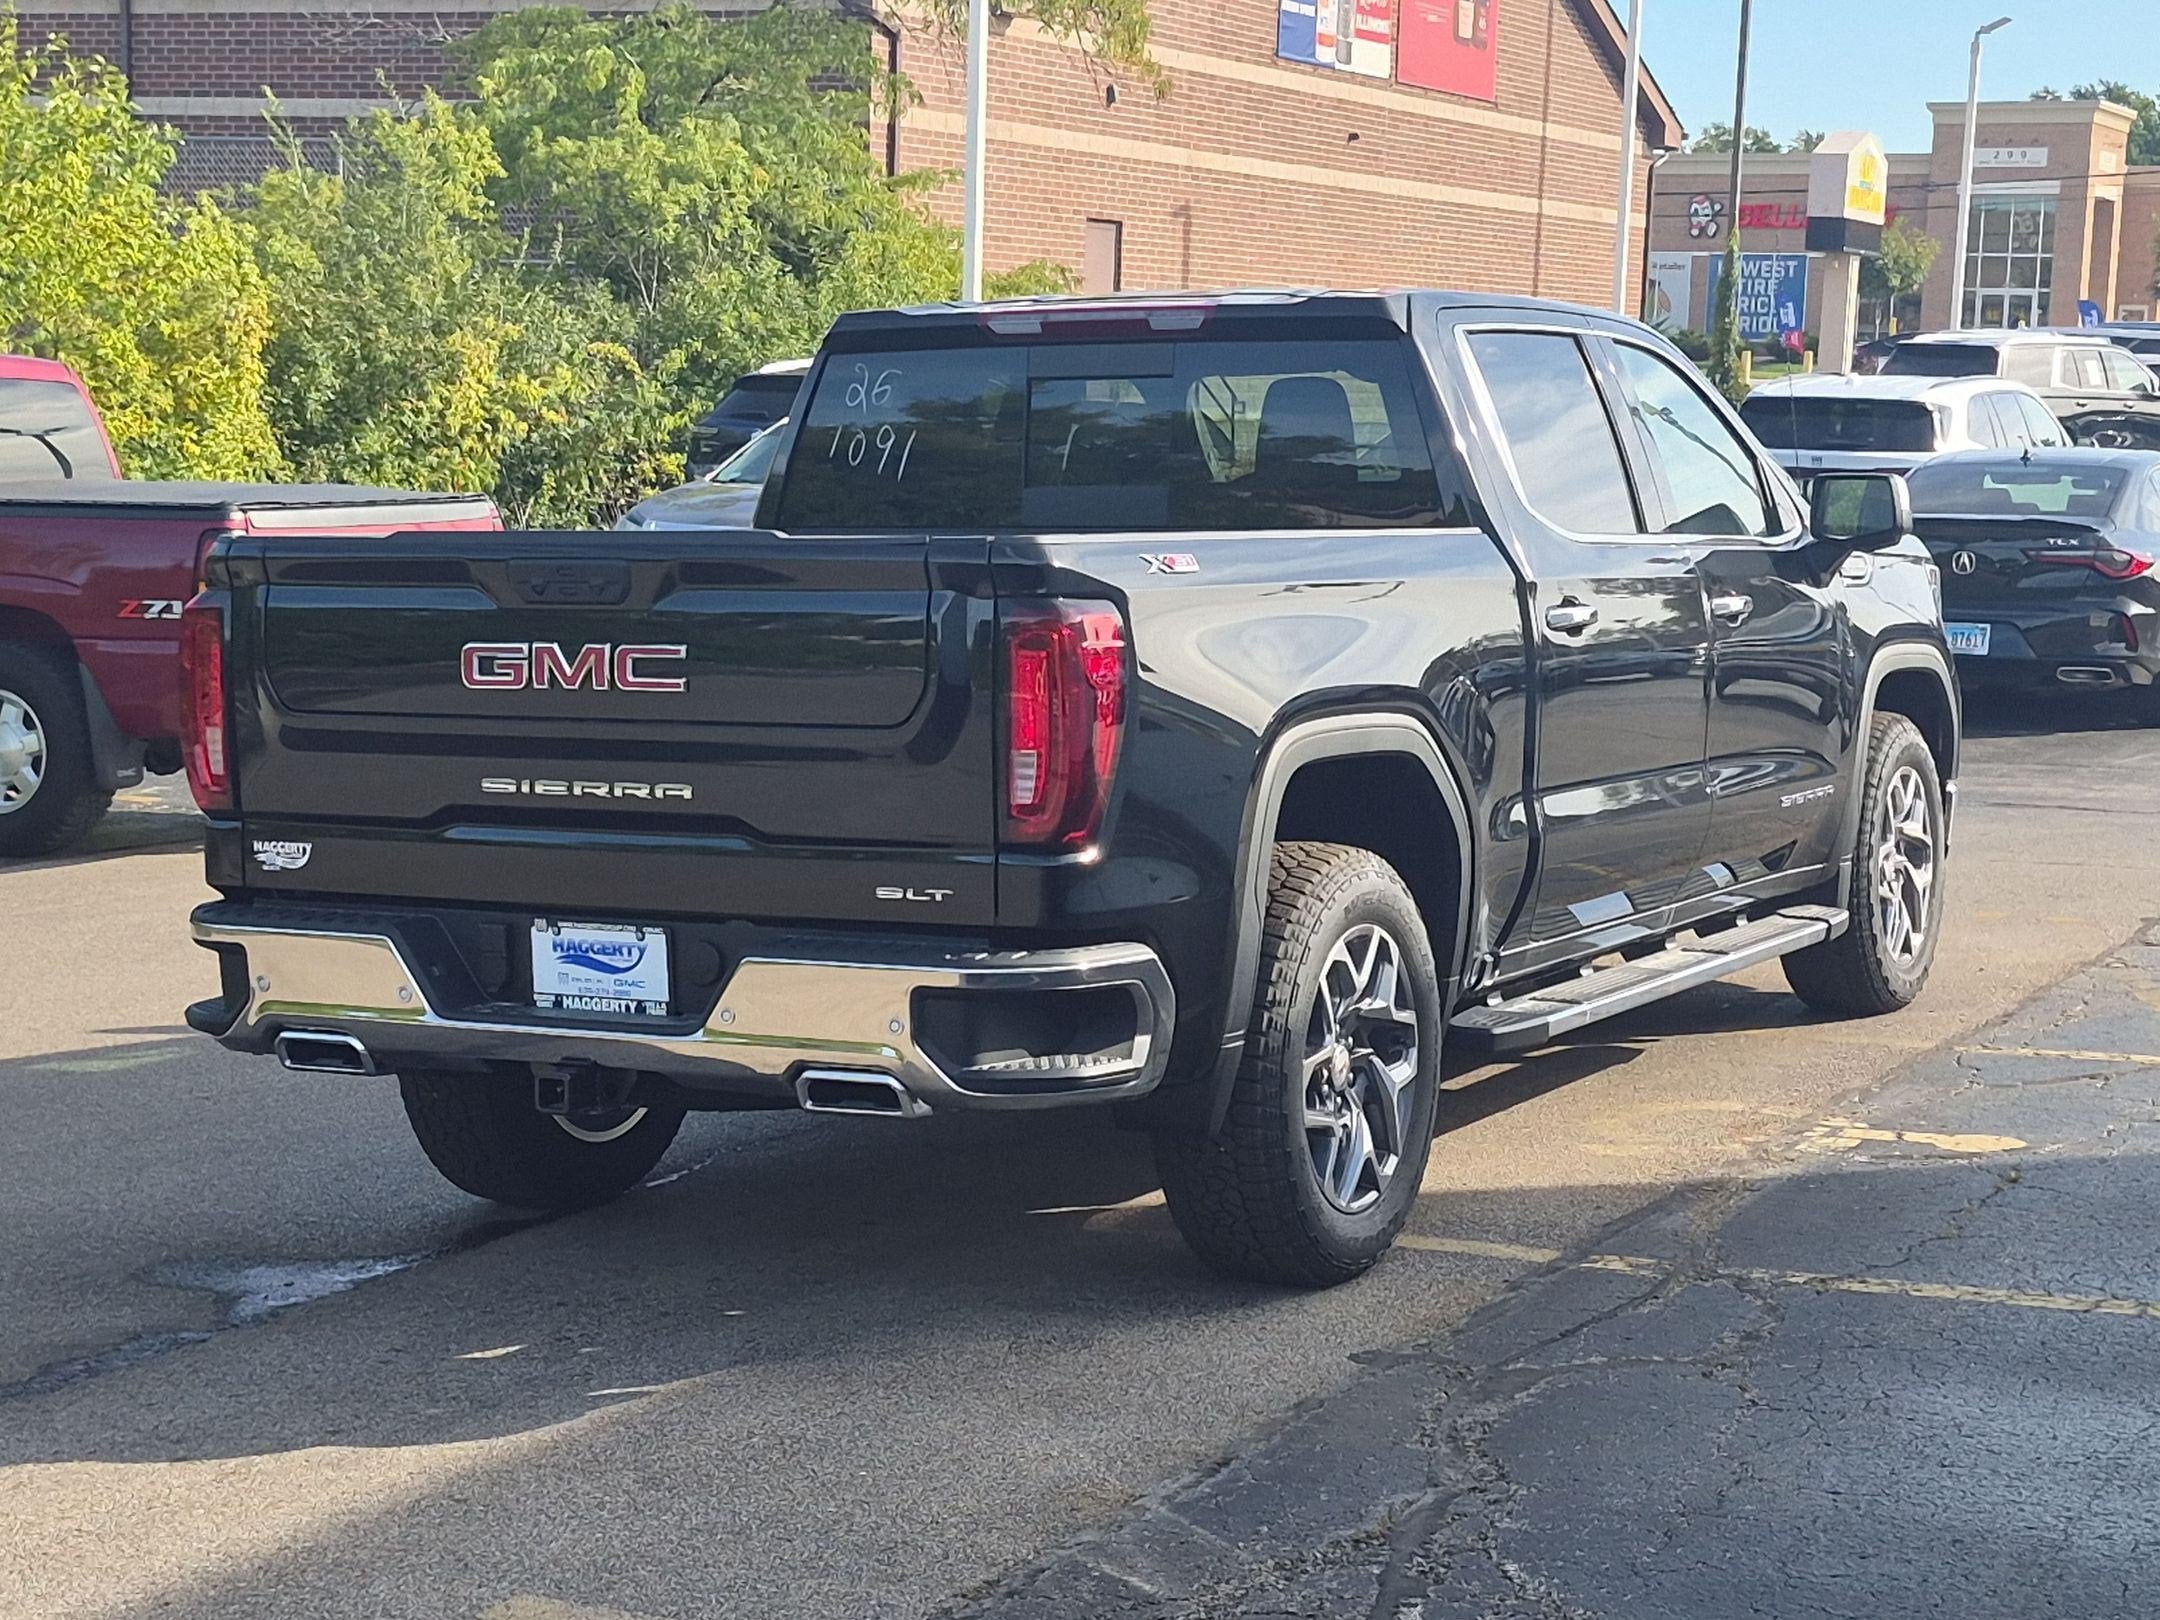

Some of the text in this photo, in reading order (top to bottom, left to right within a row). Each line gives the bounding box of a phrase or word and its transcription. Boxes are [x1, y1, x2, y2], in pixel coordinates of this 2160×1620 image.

[1739, 203, 1808, 229] BELL
[845, 363, 902, 414] 26
[829, 424, 917, 482] 1091
[2046, 537, 2079, 546] TLX
[118, 600, 183, 619] Z71
[461, 641, 689, 692] GMC
[481, 777, 693, 800] SIERRA
[875, 886, 954, 901] SLT
[551, 939, 648, 958] HAGGERTY
[613, 978, 646, 989] GMC
[562, 996, 637, 1014] HAGGERTY
